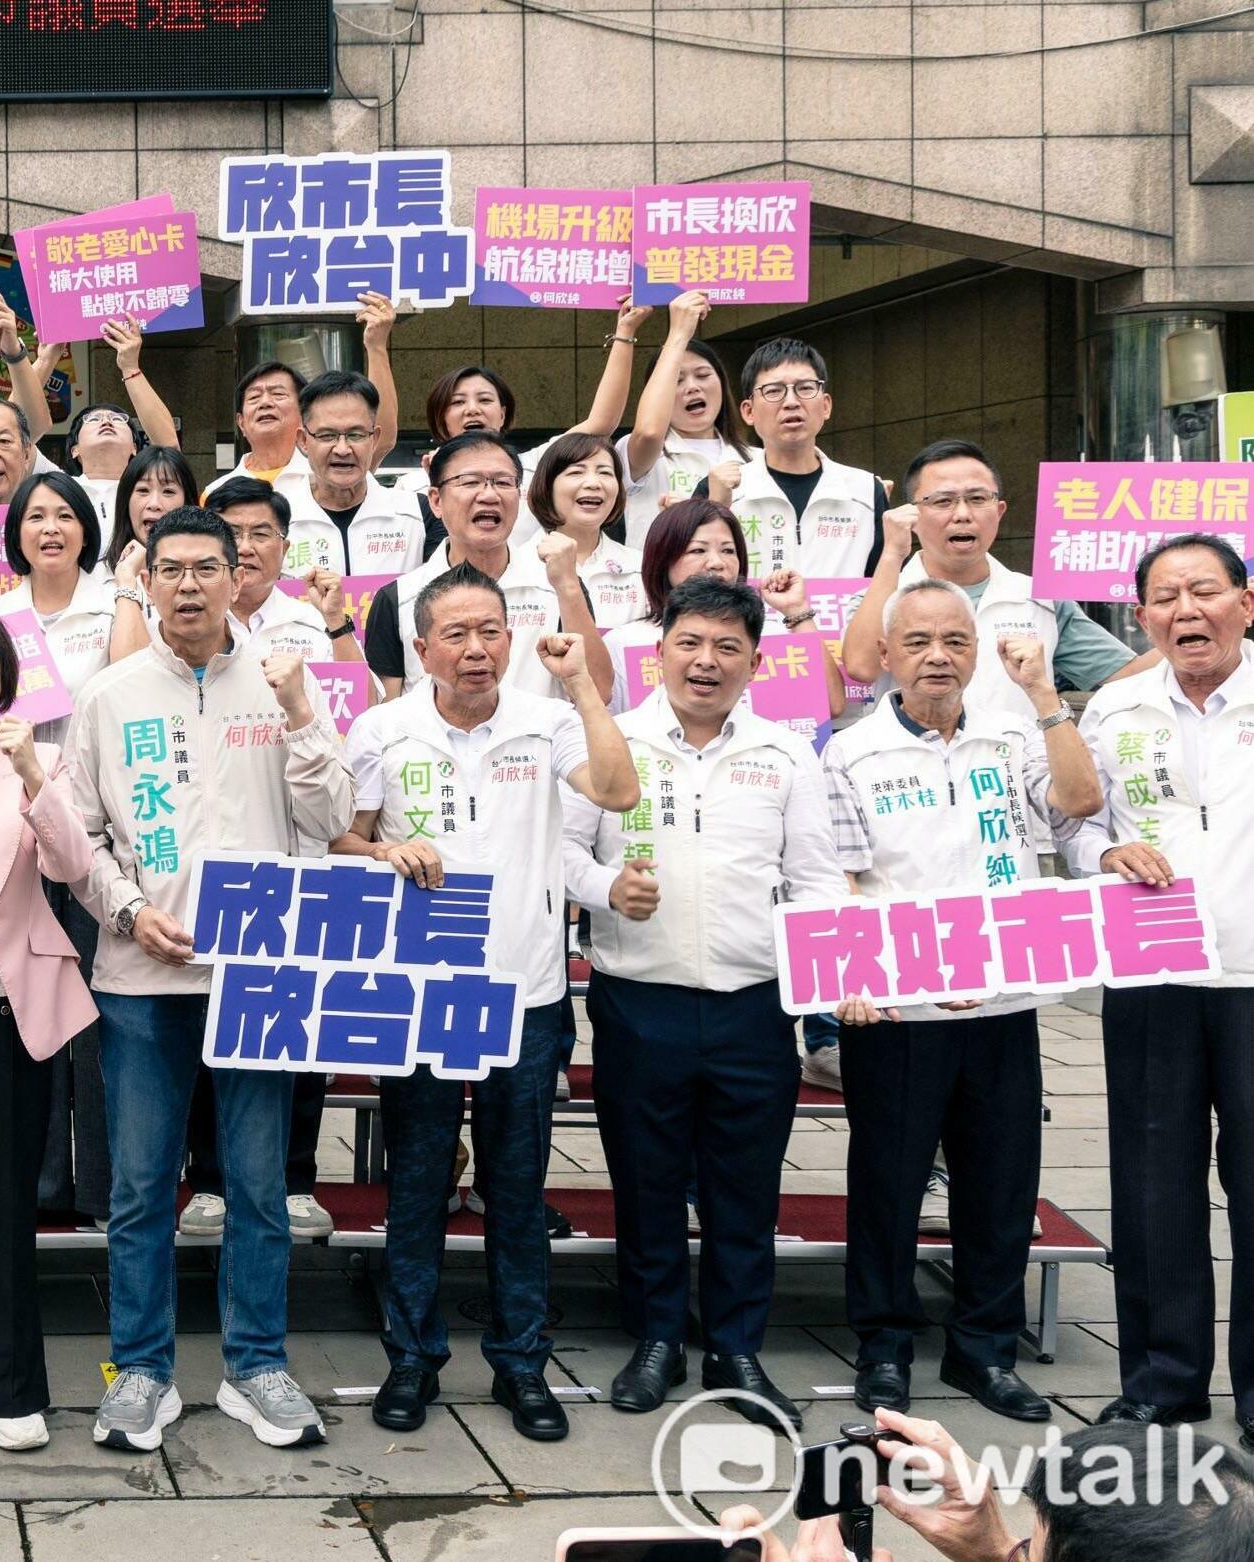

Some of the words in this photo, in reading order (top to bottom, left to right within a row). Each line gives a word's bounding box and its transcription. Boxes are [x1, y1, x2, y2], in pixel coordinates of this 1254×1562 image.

[227, 158, 444, 233] 欣市長
[646, 195, 797, 236] 市長換欣
[486, 202, 634, 243] 機場升級
[46, 223, 185, 265] 敬老愛心卡
[645, 244, 796, 284] 普發現金
[49, 261, 138, 294] 擴大使用
[250, 230, 468, 306] 欣台中
[484, 245, 633, 286] 航線擴增
[80, 283, 190, 318] 點數不歸零
[542, 291, 581, 305] 何欣純
[708, 287, 746, 301] 何欣純
[1053, 477, 1250, 522] 老人健保
[367, 539, 407, 554] 何欣純
[817, 524, 859, 539] 何欣純
[1050, 529, 1246, 573] 補助
[287, 542, 313, 570] 張
[599, 590, 638, 605] 何欣純
[171, 730, 191, 784] 市議員
[491, 765, 538, 784] 何欣純
[1153, 751, 1176, 798] 市議員
[122, 717, 180, 875] 周永鴻
[399, 760, 437, 841] 何文
[729, 769, 781, 790] 何欣純
[440, 784, 457, 833] 市議員
[659, 780, 676, 827] 市議員
[969, 765, 1018, 888] 何欣純
[192, 859, 495, 967] 欣市長
[784, 877, 1210, 1005] 欣好市長
[213, 963, 517, 1071] 欣台中
